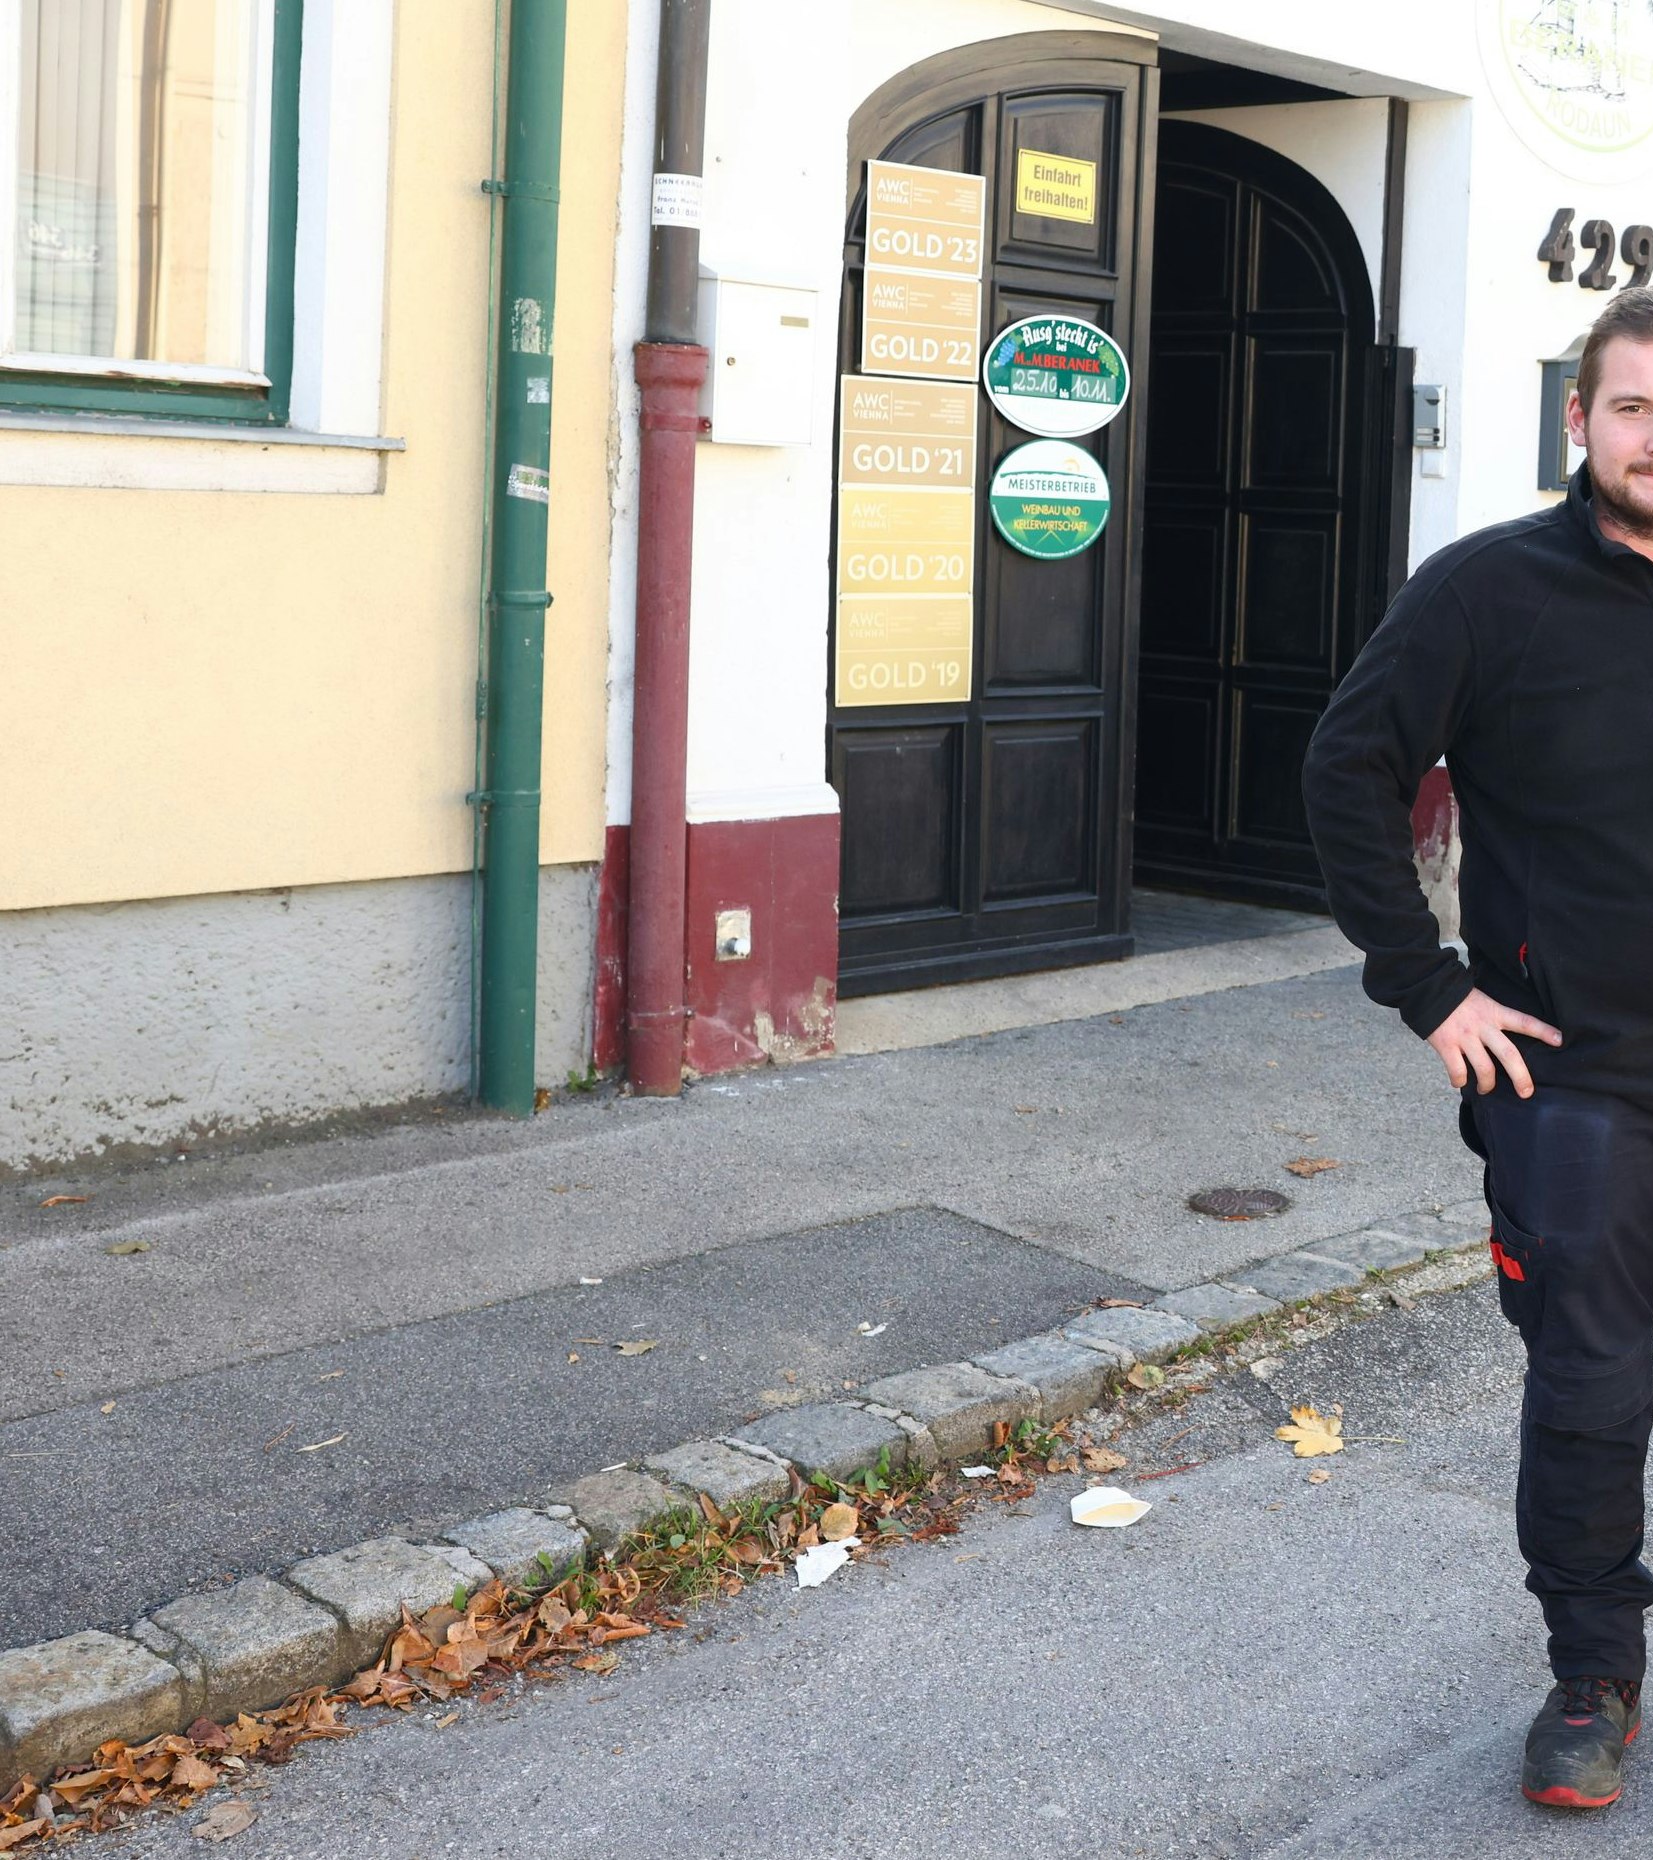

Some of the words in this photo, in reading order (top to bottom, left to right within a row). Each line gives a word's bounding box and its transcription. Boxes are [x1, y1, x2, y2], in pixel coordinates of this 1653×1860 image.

[1546, 95, 1632, 138] RODAUN
[1033, 165, 1081, 187] Einfahrt
[876, 177, 909, 195] AWC
[876, 191, 909, 205] VIENNA
[1025, 186, 1088, 211] freihalten!
[872, 227, 944, 258] GOLD
[946, 236, 977, 263] '23
[873, 283, 905, 301] AWC
[872, 298, 905, 310] VIENNA
[870, 333, 939, 363] GOLD
[943, 340, 972, 366] '22
[1056, 342, 1067, 352] bei
[994, 385, 1009, 393] vom
[1059, 387, 1069, 399] bis
[853, 391, 889, 410] AWC
[852, 409, 889, 420] VIENNA
[853, 444, 930, 474] GOLD
[934, 447, 962, 475] '21
[1008, 478, 1096, 493] MEISTERBETRIEB
[851, 502, 888, 518] AWC
[1022, 503, 1060, 515] WEINBAU
[1061, 505, 1081, 516] UND
[1013, 519, 1088, 532] KELLERWIRTSCHAFT
[847, 553, 925, 581] GOLD
[928, 554, 965, 581] '20
[848, 611, 885, 628] AWC
[848, 662, 927, 690] GOLD
[931, 661, 960, 688] '19
